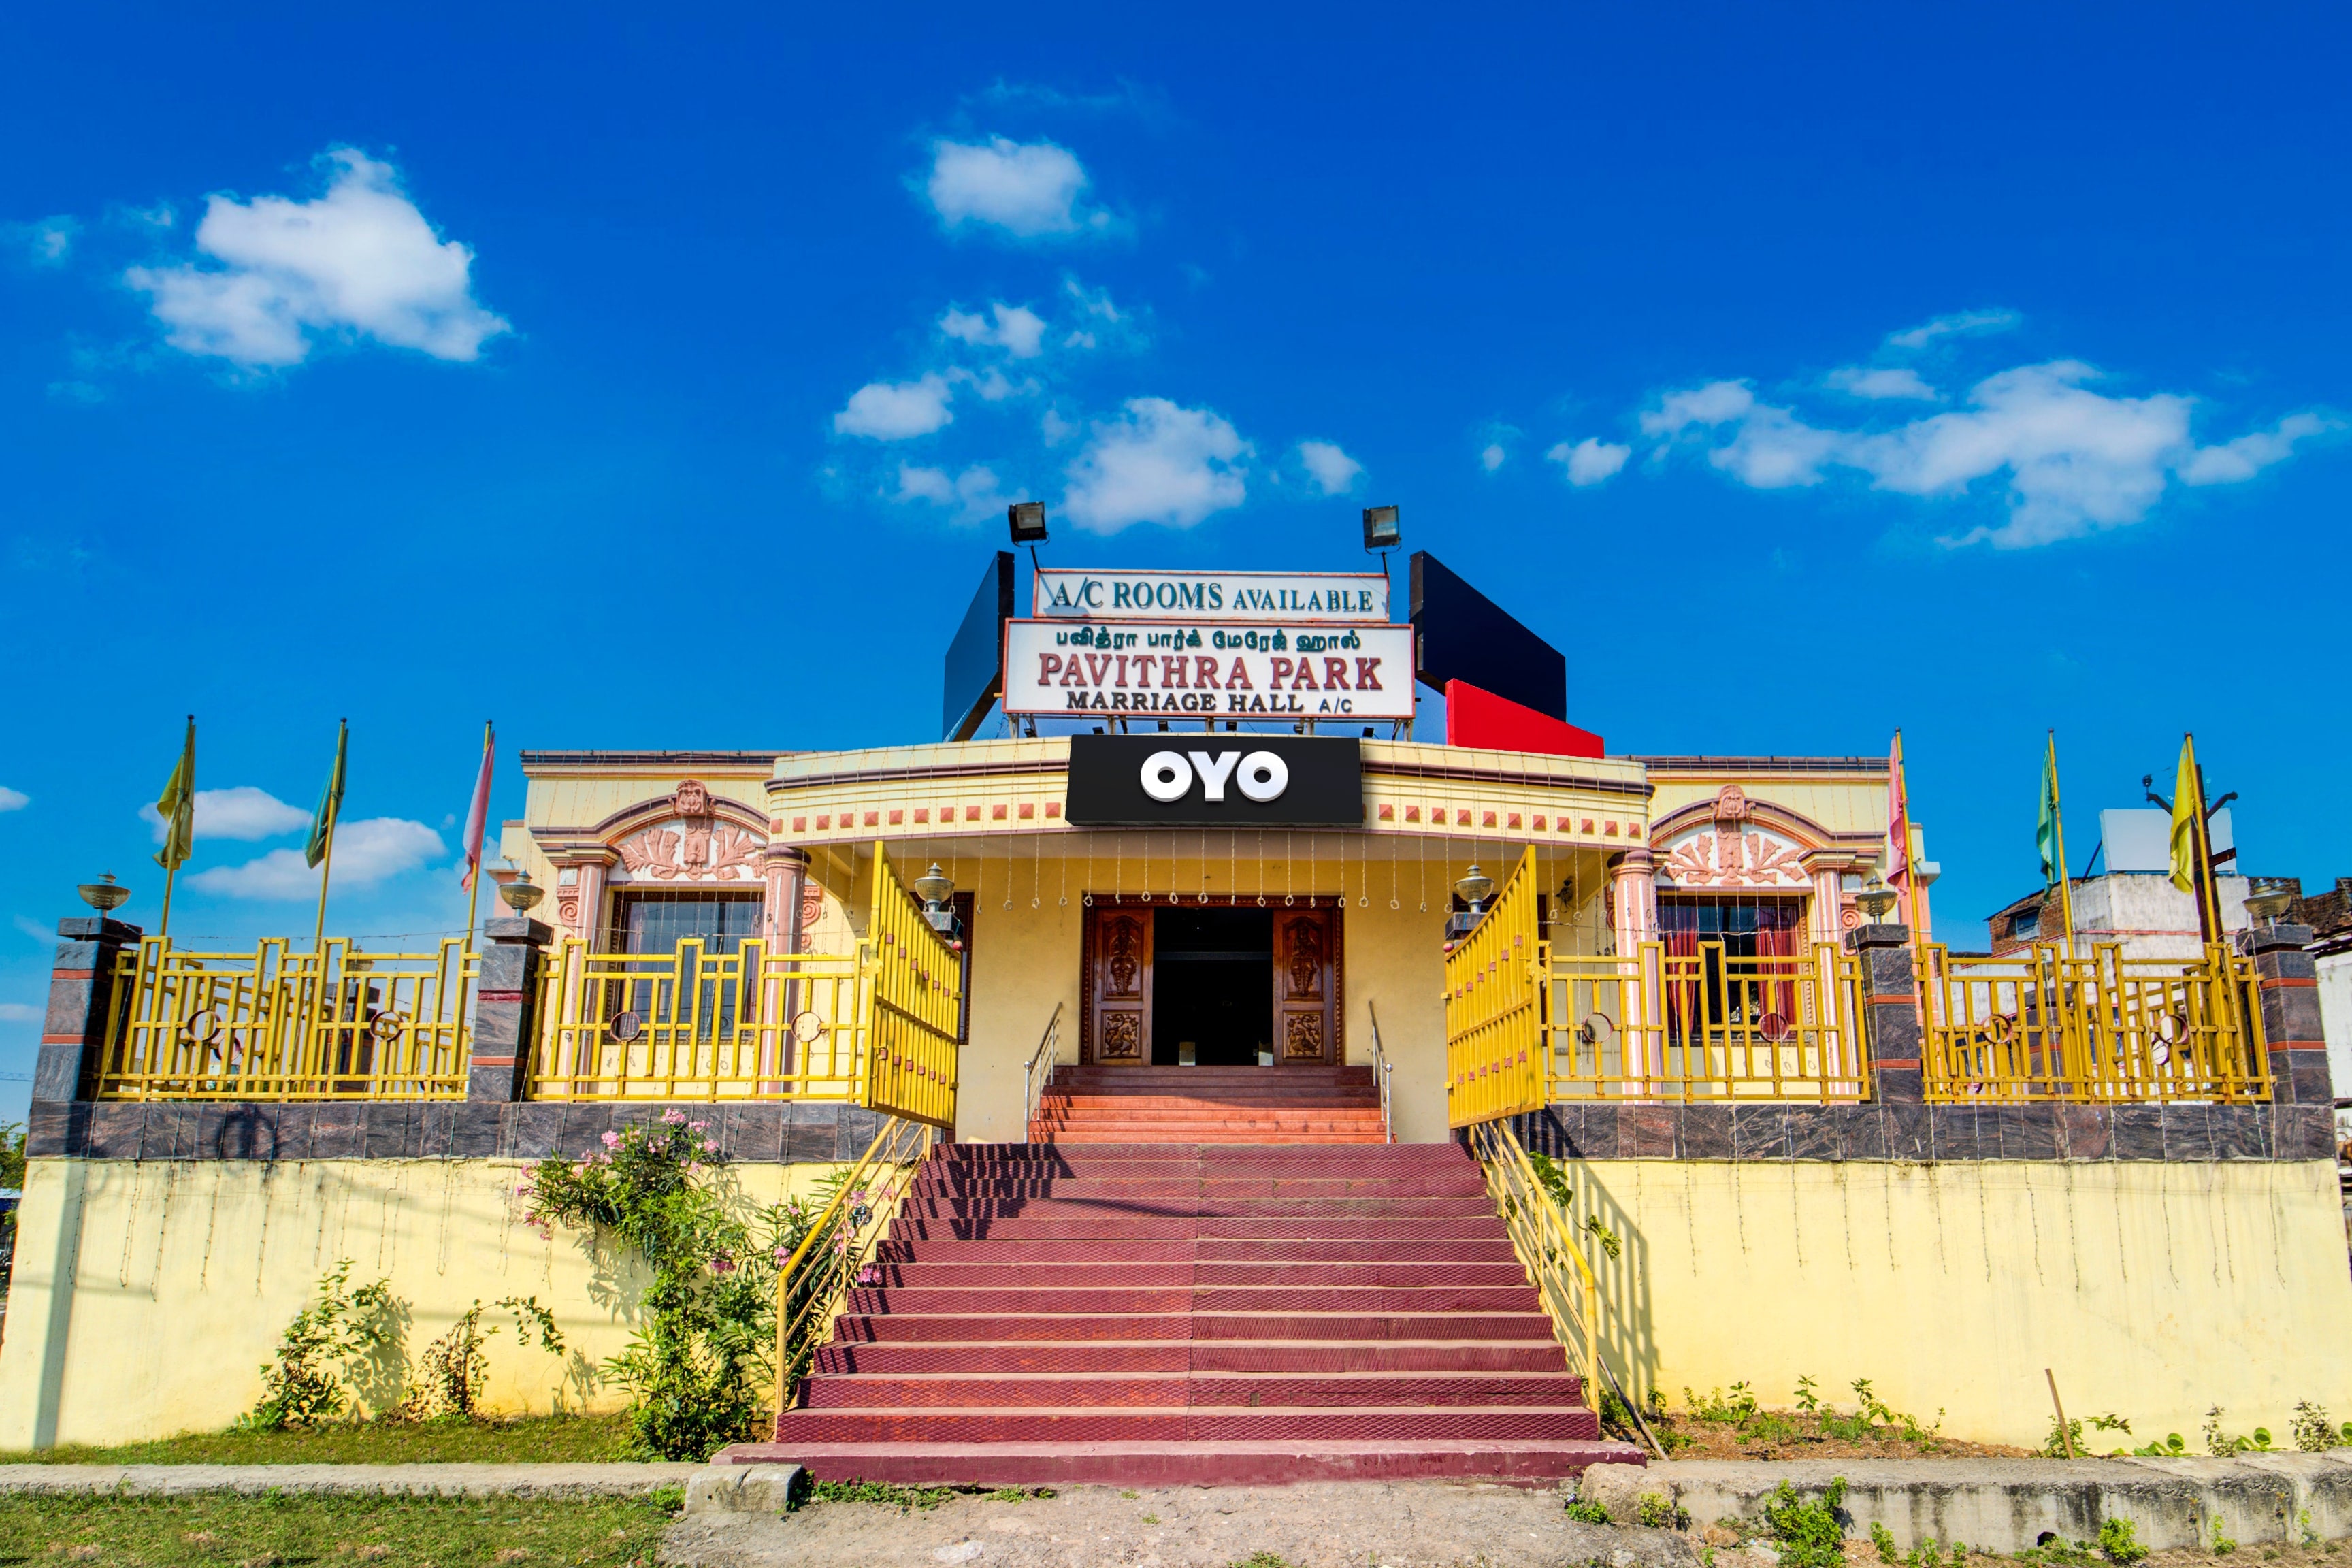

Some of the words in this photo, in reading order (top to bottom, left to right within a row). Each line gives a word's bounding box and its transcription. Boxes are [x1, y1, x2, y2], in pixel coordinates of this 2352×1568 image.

[1052, 576, 1103, 608] A/C
[1112, 581, 1223, 610] ROOMS
[1233, 589, 1373, 612] AVAILABLE
[1056, 626, 1137, 649] பவித்ரா
[1147, 628, 1203, 650] பார்க்
[1212, 628, 1287, 652] மேரேஜ்
[1296, 629, 1360, 652] ஹால்
[1038, 653, 1253, 689] PAVITHRA
[1270, 657, 1382, 690] PARK
[1067, 691, 1216, 711] MARRIAGE
[1228, 693, 1304, 712] HALL
[1319, 696, 1352, 713] A/C
[1140, 751, 1288, 802] OYO
